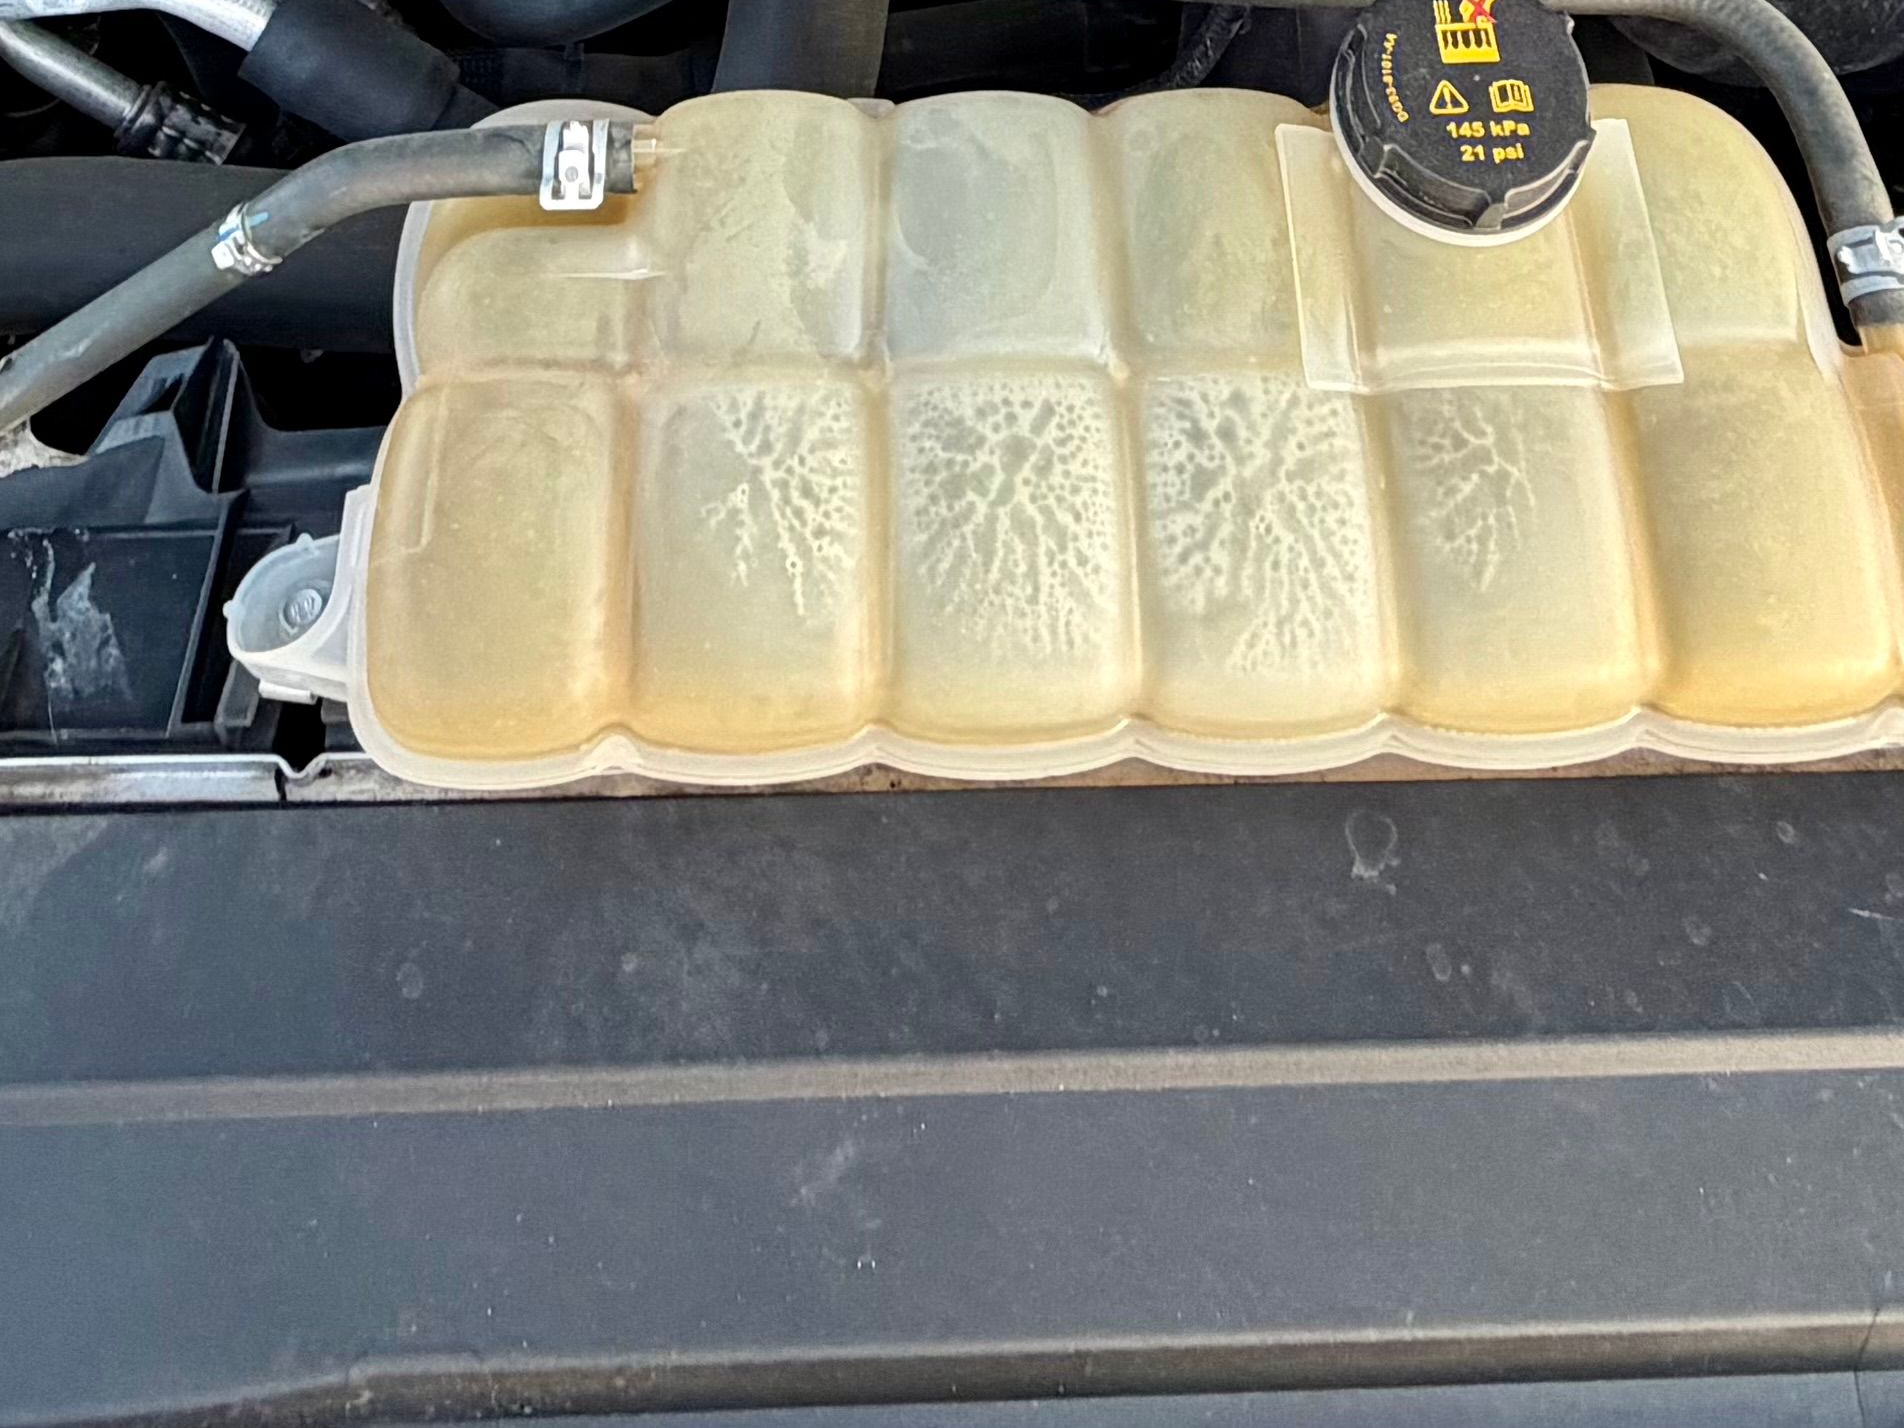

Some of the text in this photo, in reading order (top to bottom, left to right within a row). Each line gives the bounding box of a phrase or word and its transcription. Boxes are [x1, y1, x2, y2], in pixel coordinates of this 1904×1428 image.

[1446, 120, 1530, 139] 145 kPa
[1460, 144, 1523, 164] 21 psi
